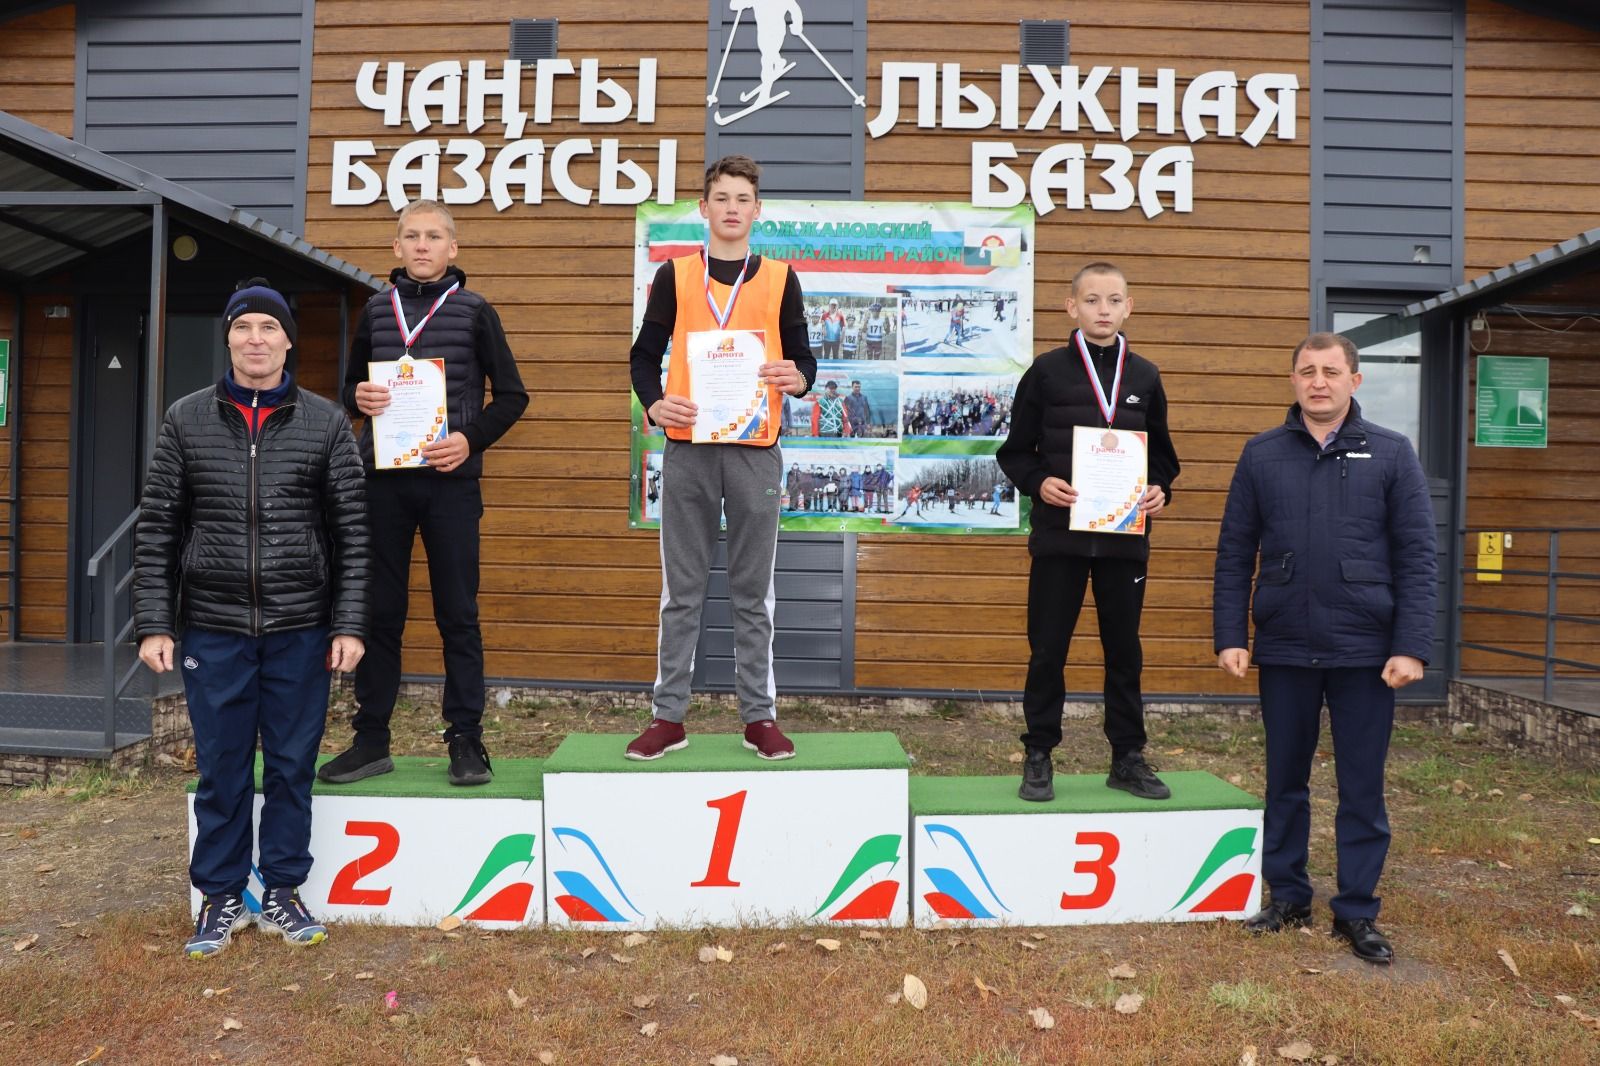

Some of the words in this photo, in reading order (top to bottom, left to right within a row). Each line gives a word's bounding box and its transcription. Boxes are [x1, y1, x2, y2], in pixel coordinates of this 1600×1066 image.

[355, 58, 657, 139] ЧАҢГЫ
[867, 61, 1299, 148] ЛЫЖНАЯ
[331, 138, 678, 212] БАЗАСЫ
[971, 141, 1195, 219] БАЗА
[749, 219, 933, 240] РОЖЖАНОВСКИЙ
[892, 243, 962, 262] РАЙОН
[388, 379, 423, 388] Грамота
[707, 351, 744, 359] Грамота
[327, 820, 399, 905] 2
[690, 790, 747, 887] 1
[1060, 832, 1120, 910] 3
